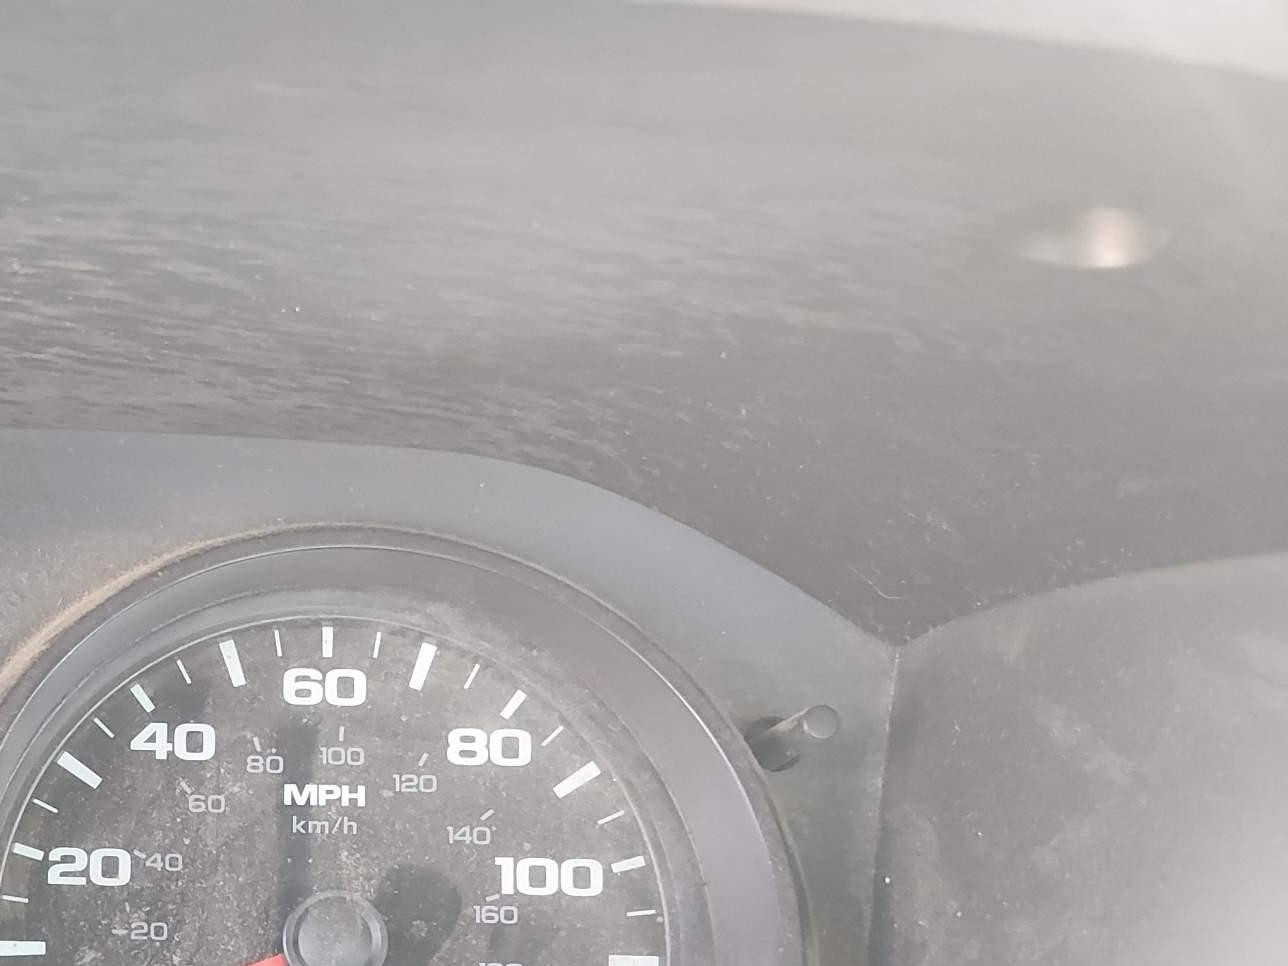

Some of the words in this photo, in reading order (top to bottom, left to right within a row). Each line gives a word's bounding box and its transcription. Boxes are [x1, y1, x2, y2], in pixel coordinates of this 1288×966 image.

[283, 668, 367, 706] 60
[130, 723, 216, 760] 40
[446, 728, 532, 766] 80
[246, 755, 284, 774] 80
[319, 746, 365, 766] 100
[393, 774, 437, 793] 120
[188, 794, 226, 814] 60
[283, 784, 366, 807] MPH
[292, 816, 357, 835] km/h
[446, 825, 491, 845] 140
[47, 847, 132, 886] 20
[145, 852, 184, 872] 40
[494, 857, 604, 897] 100
[473, 905, 519, 924] 160
[129, 922, 168, 941] 20
